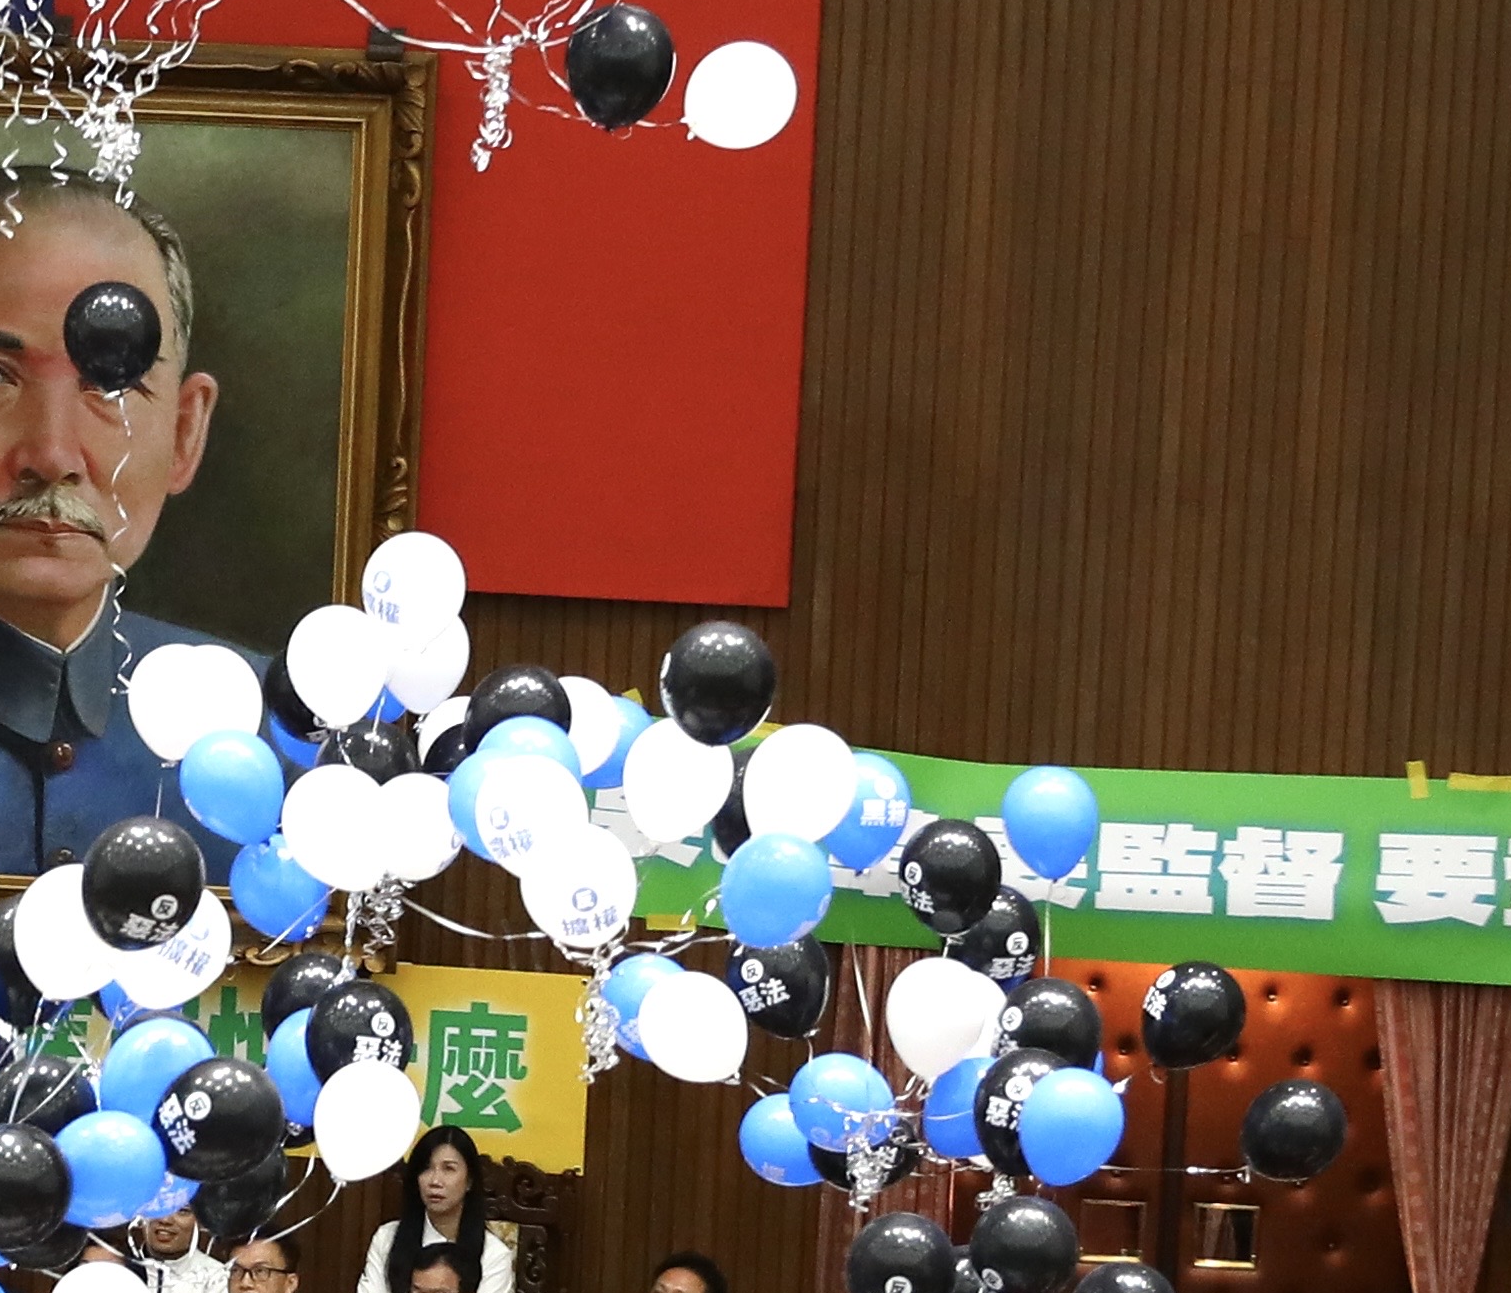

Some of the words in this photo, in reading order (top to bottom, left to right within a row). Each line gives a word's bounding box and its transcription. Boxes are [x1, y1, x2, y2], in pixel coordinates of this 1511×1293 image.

[151, 894, 178, 919] 反
[122, 912, 181, 943] 惡法
[1006, 931, 1030, 956] 反
[741, 957, 765, 983] 反
[738, 976, 791, 1012] 惡法
[370, 1012, 395, 1038] 反
[353, 1034, 402, 1067] 惡法
[184, 1091, 211, 1120] 反
[158, 1093, 198, 1155] 惡法
